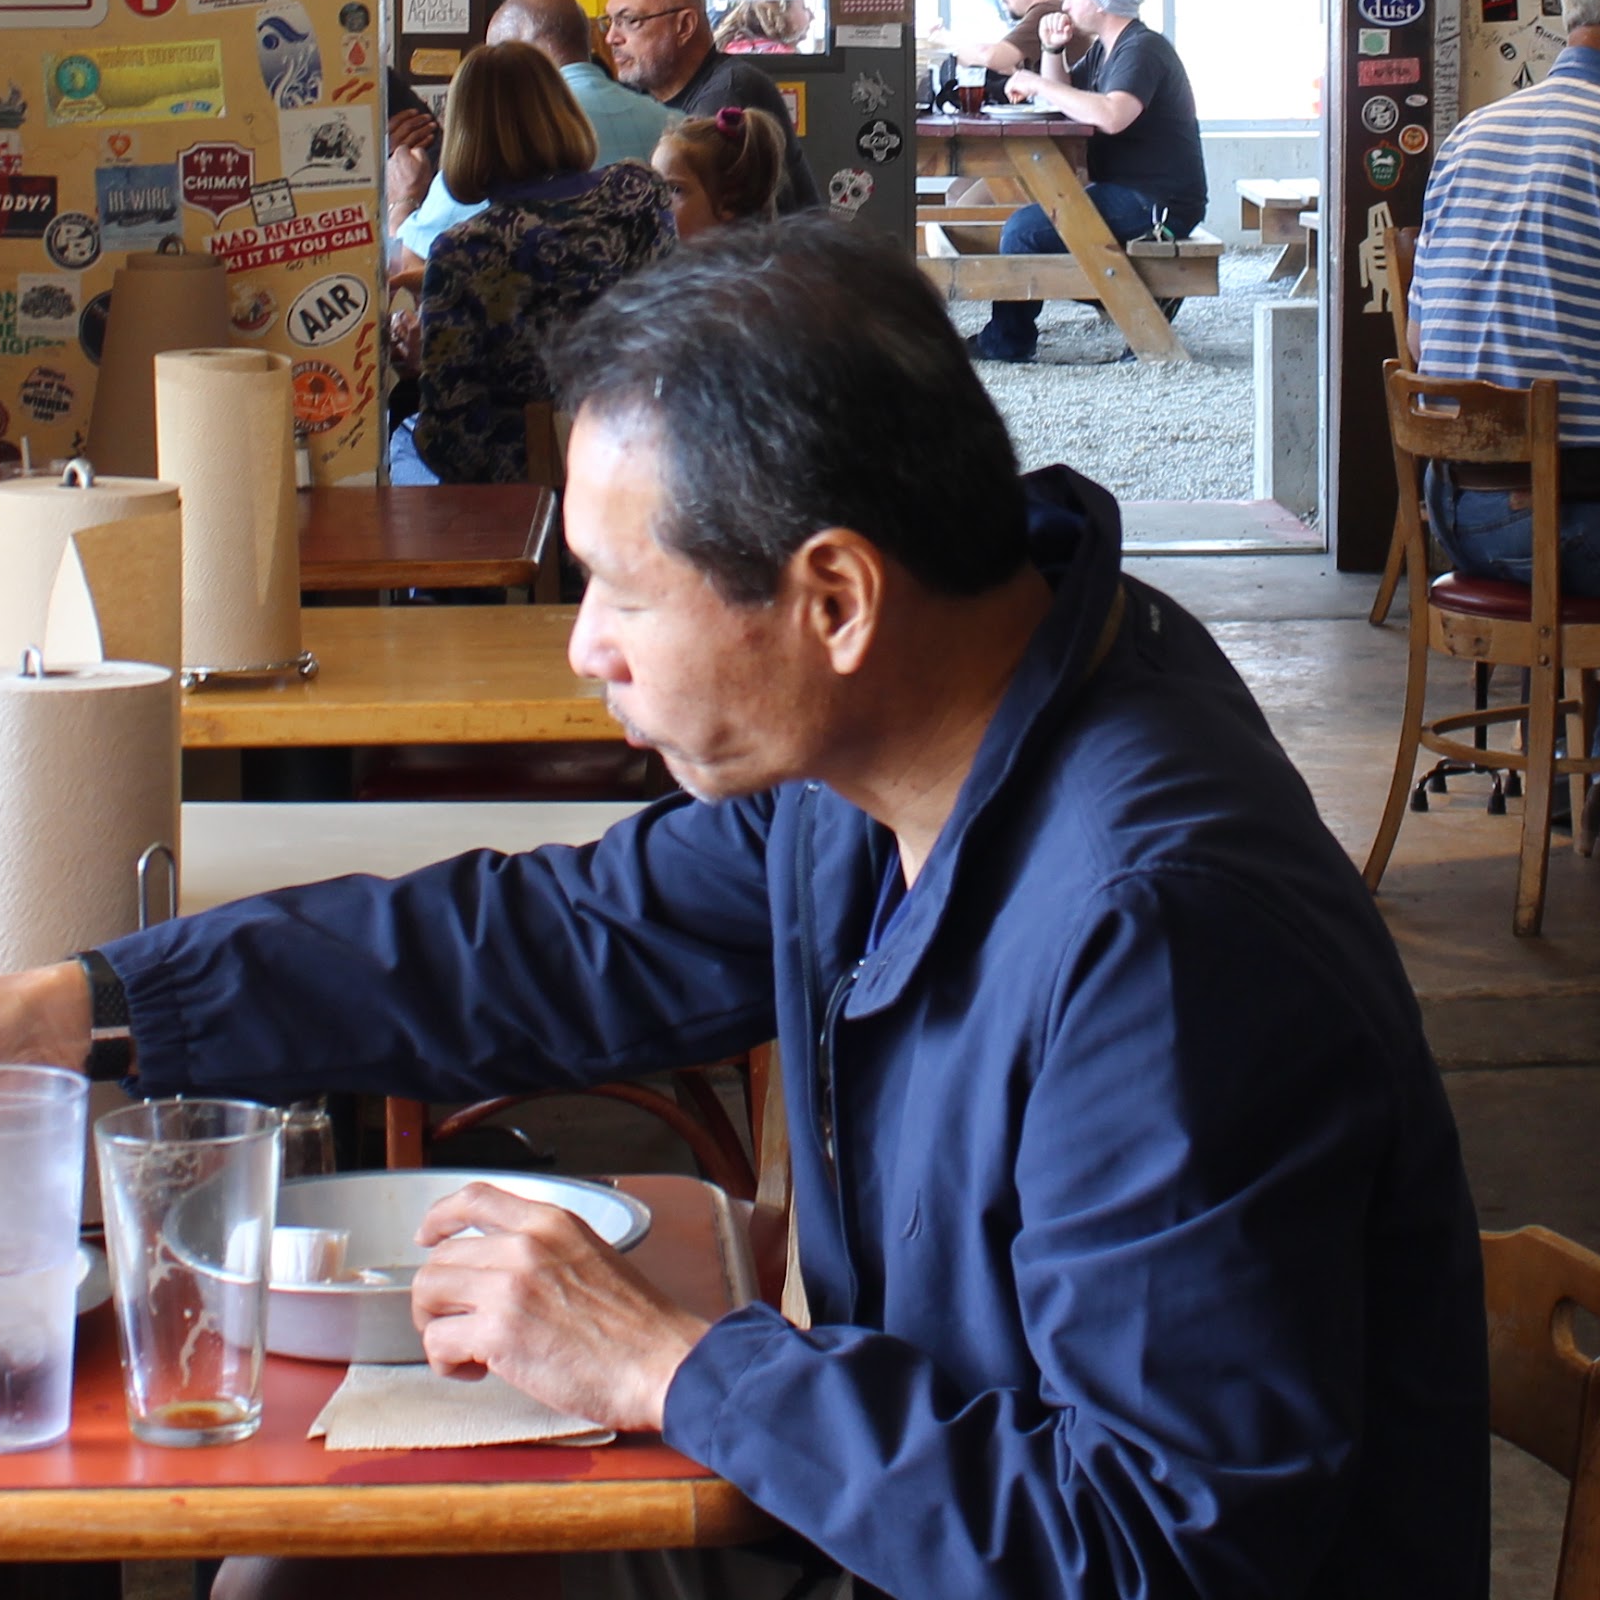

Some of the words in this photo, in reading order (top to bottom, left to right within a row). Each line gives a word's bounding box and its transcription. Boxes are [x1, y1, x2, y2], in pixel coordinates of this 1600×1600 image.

[407, 4, 469, 25] Aquatic
[1367, 0, 1415, 20] dust
[184, 175, 248, 190] CHIMAY
[210, 226, 258, 254] MAD
[263, 216, 318, 243] RIVER
[318, 205, 365, 232] GLEN
[225, 255, 243, 270] KI
[248, 251, 264, 268] IT
[269, 247, 284, 262] IF
[289, 236, 327, 258] YOU
[330, 226, 369, 248] CAN
[299, 282, 361, 342] AAR
